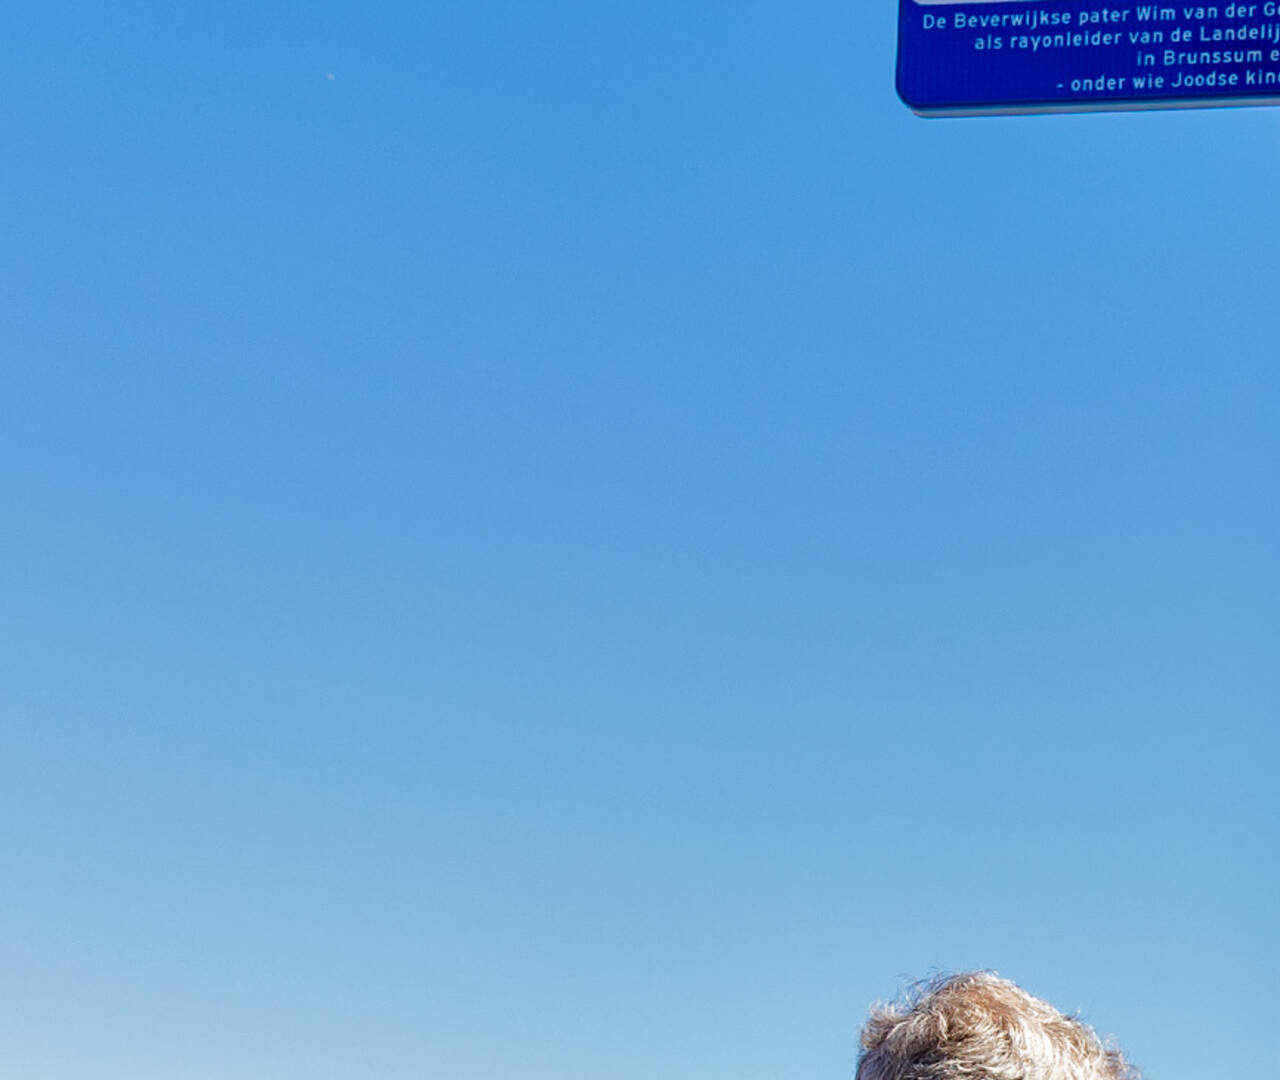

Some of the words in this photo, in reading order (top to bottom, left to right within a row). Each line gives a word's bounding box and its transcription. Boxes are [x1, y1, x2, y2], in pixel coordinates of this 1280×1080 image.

[923, 14, 947, 29] De
[954, 10, 1071, 30] Beverwijkse
[1079, 8, 1130, 26] pater
[1136, 5, 1176, 21] Wim
[1183, 6, 1218, 20] van
[1225, 2, 1257, 19] der
[974, 33, 1003, 50] als
[1010, 30, 1122, 52] rayonleider
[1128, 31, 1163, 44] van
[1170, 27, 1193, 42] de
[1137, 53, 1155, 66] in
[1163, 49, 1262, 66] Brunssum
[1070, 75, 1126, 92] onder
[1132, 74, 1164, 89] wie
[1171, 71, 1239, 88] Joodse
